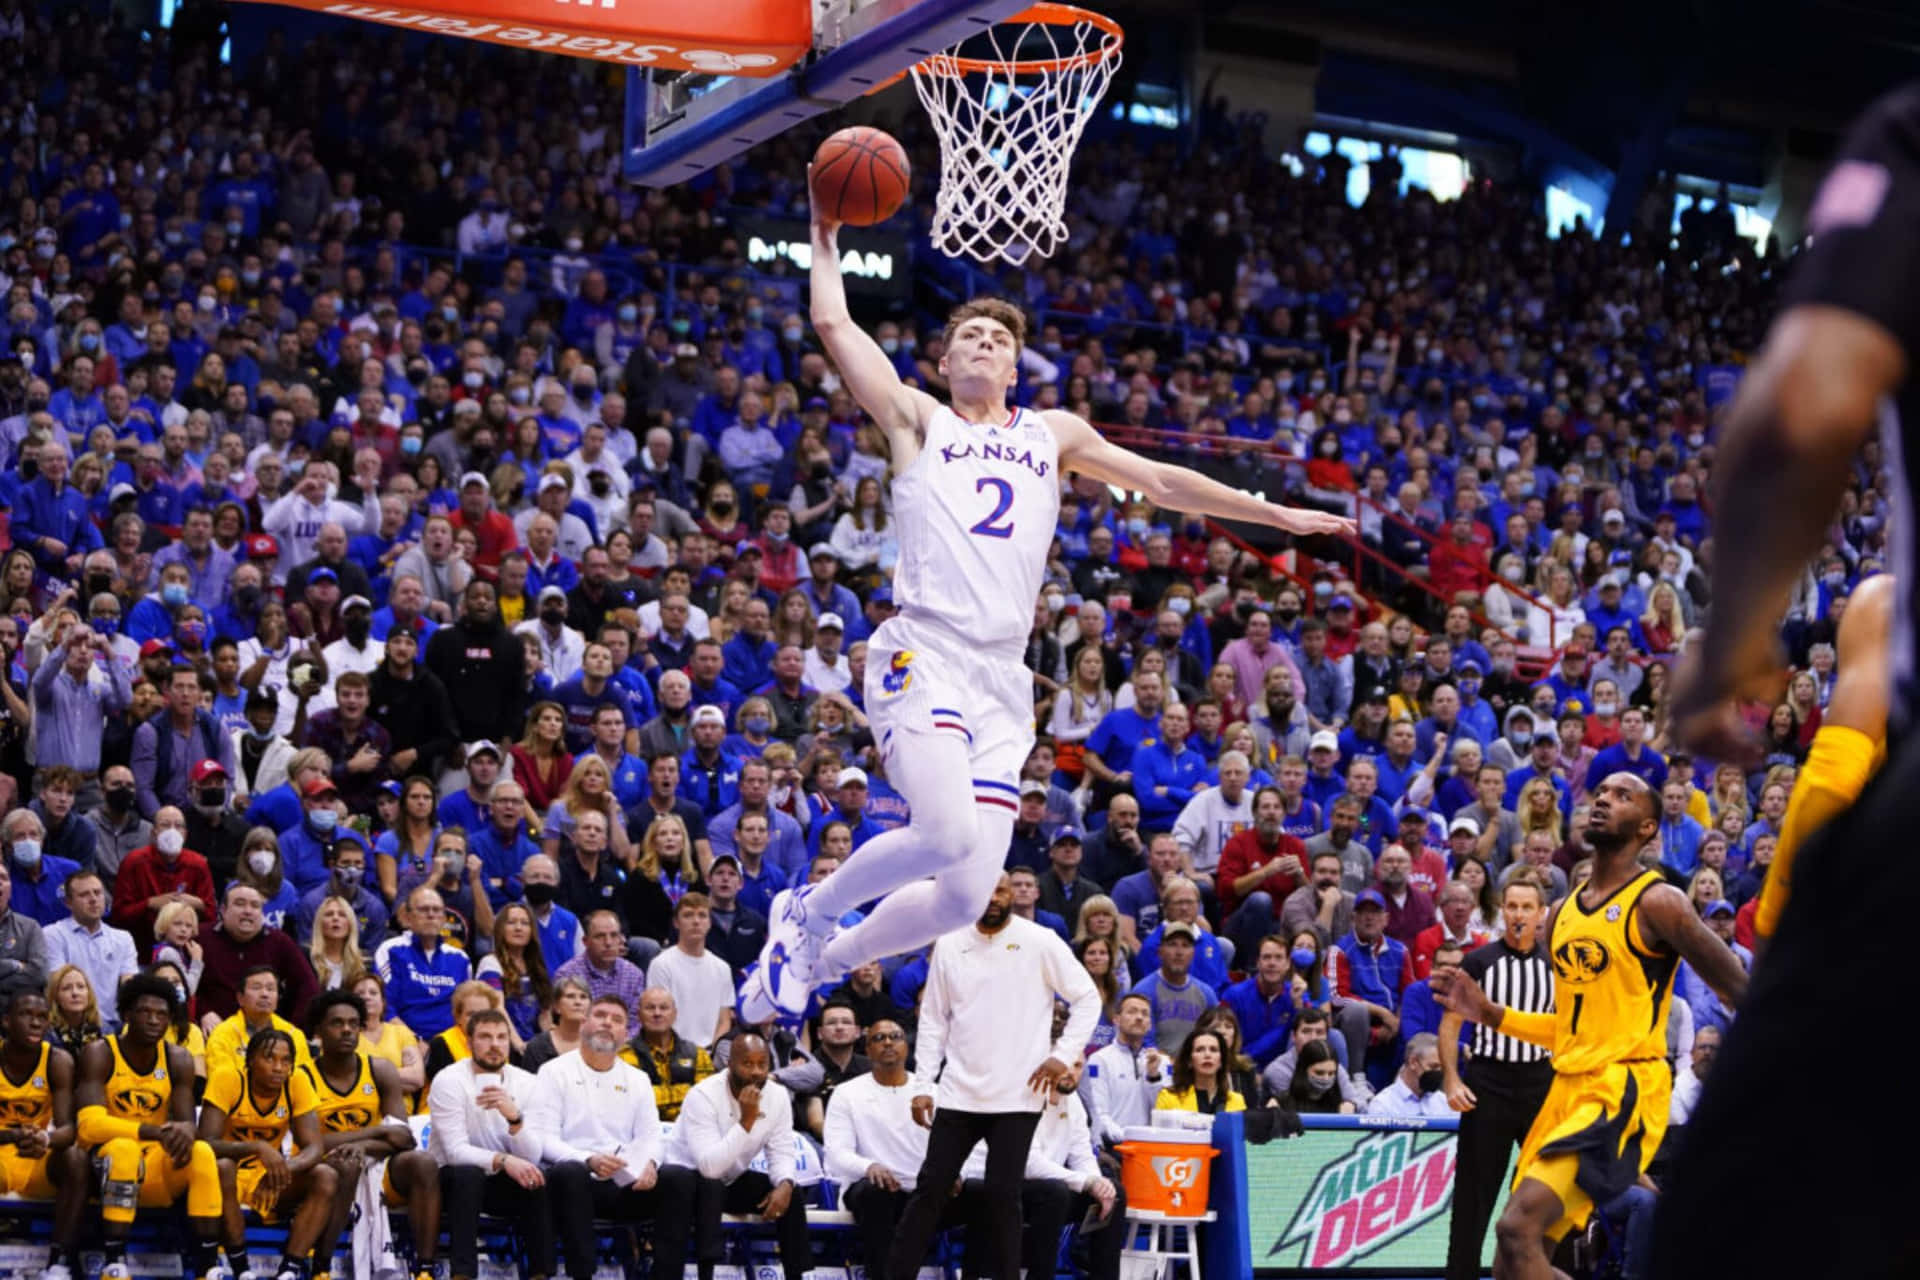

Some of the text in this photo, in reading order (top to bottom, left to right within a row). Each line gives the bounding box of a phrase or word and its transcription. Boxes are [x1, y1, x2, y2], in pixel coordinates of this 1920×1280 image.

[940, 442, 1050, 478] KANSAS
[969, 476, 1015, 539] 2
[1571, 993, 1584, 1035] 1
